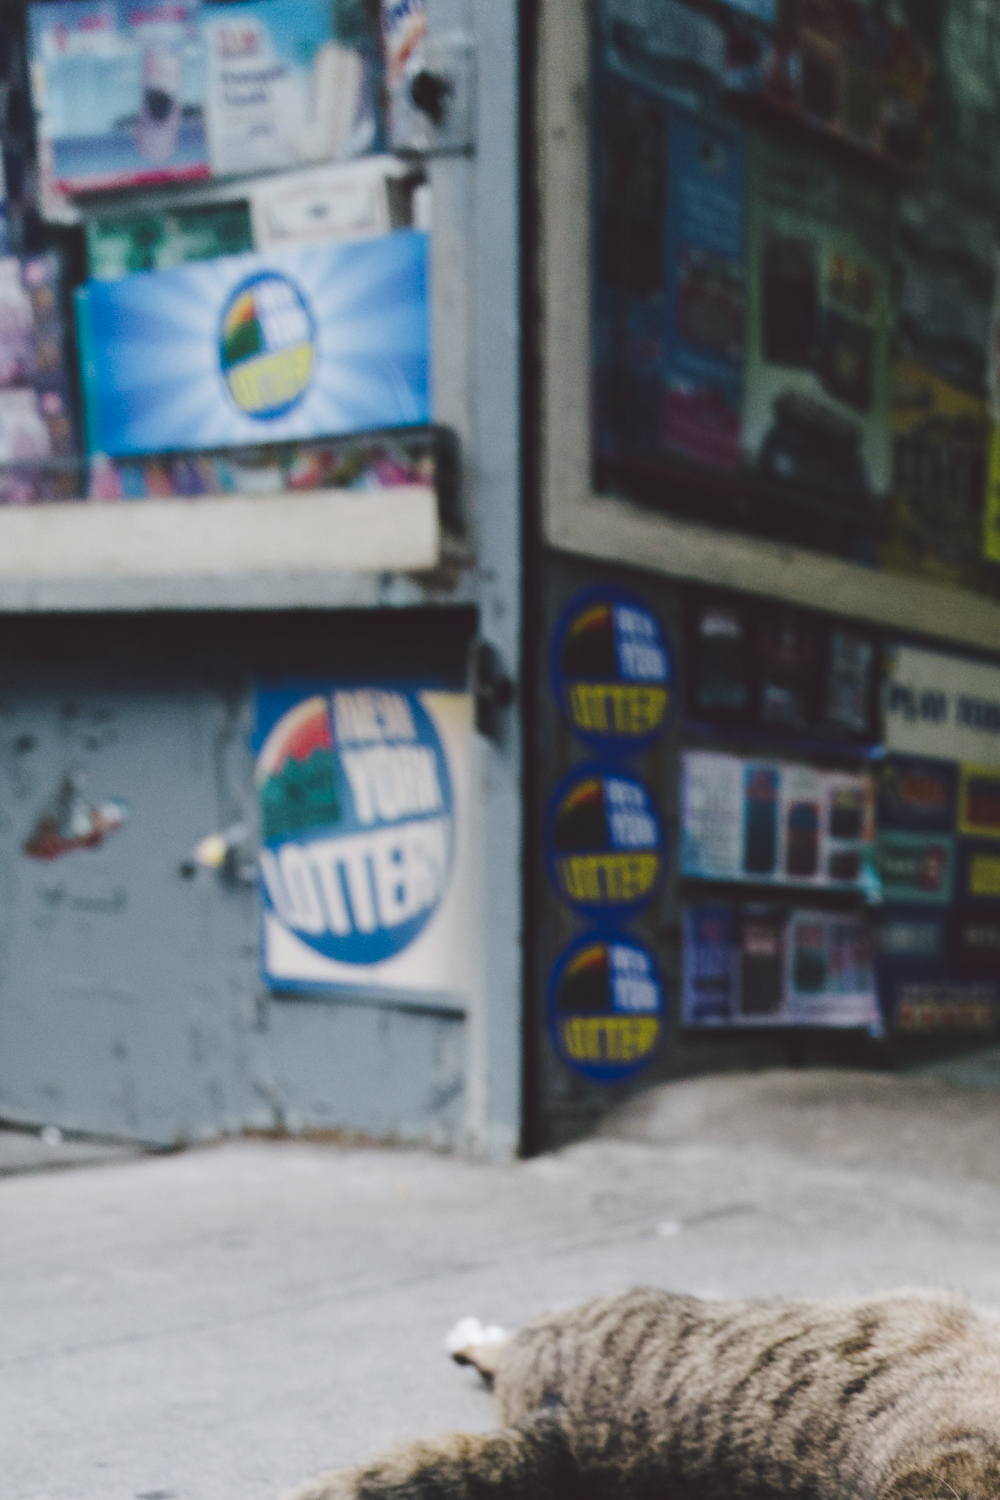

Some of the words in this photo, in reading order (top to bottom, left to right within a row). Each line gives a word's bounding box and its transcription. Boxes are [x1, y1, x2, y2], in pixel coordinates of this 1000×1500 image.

[332, 687, 417, 742] NEW
[344, 745, 444, 824] YORK
[259, 818, 453, 937] LOTTERY
